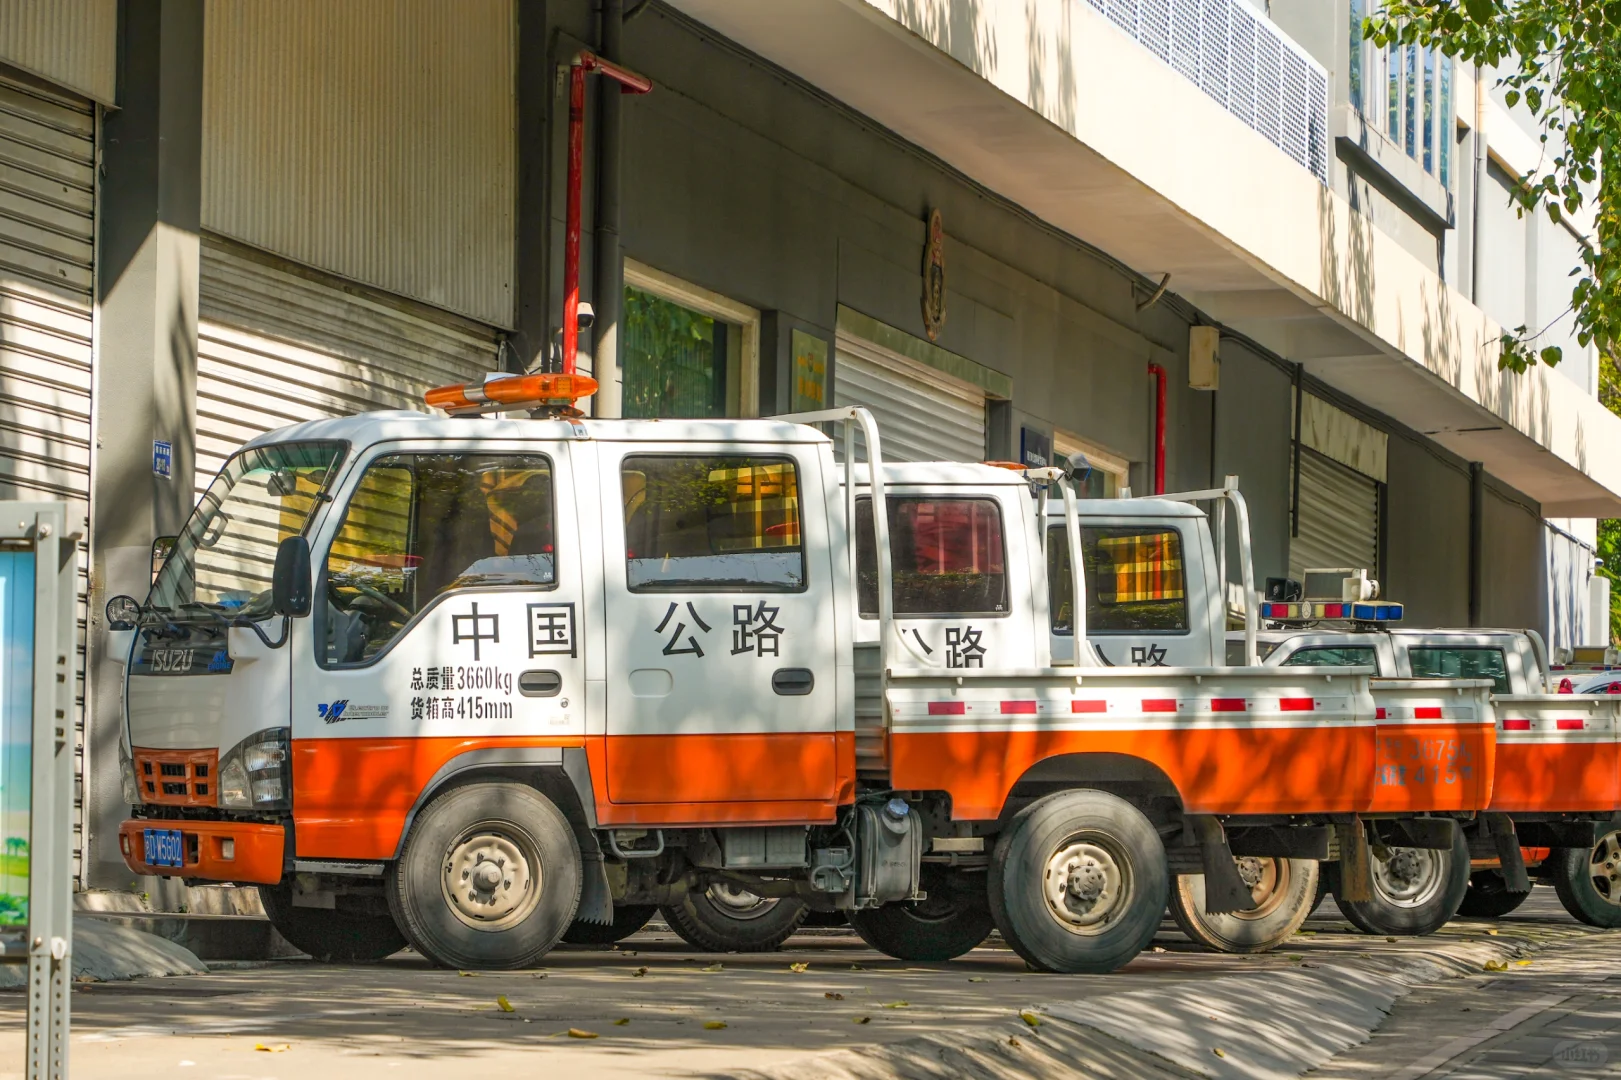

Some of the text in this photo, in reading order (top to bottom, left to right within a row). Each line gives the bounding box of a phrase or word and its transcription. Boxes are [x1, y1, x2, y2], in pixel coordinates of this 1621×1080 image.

[452, 600, 785, 661] 中国 公路
[150, 649, 195, 671] ISUZU
[410, 666, 512, 695] 总质量3660kg
[410, 696, 513, 720] 货箱高415mm
